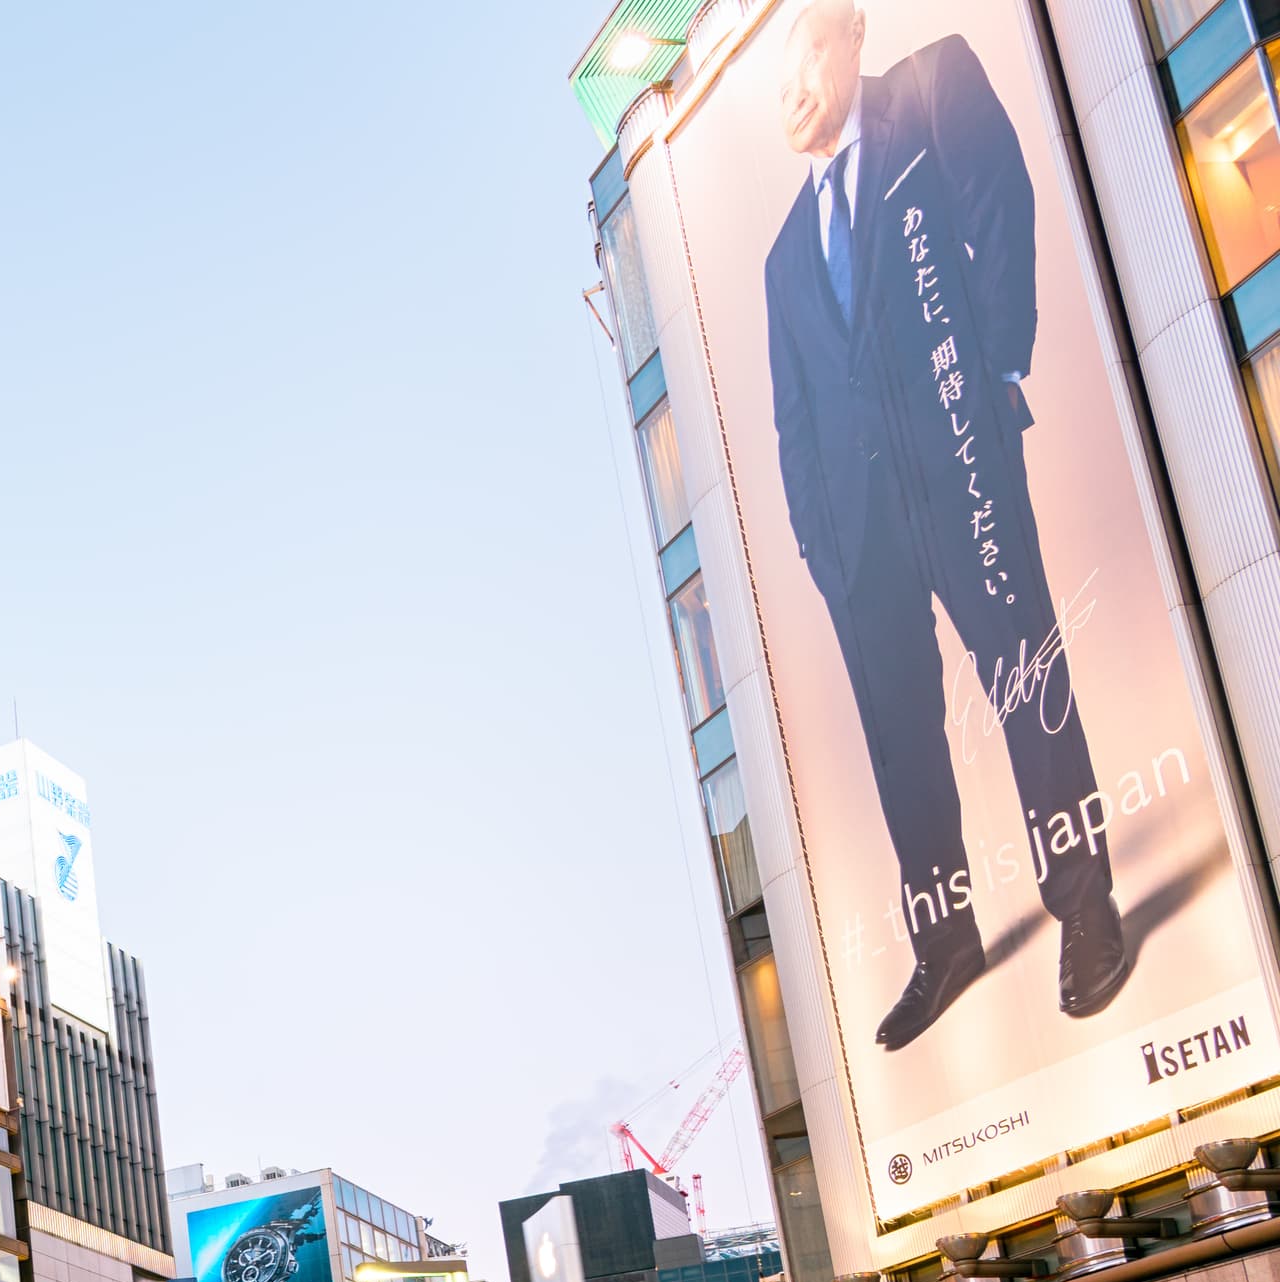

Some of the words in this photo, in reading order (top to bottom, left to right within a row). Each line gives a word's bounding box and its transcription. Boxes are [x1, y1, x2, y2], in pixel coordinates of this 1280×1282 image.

[1028, 744, 1190, 885] japan
[1140, 1015, 1251, 1086] ISETAN
[922, 1110, 1030, 1167] MITSUKOSHI
